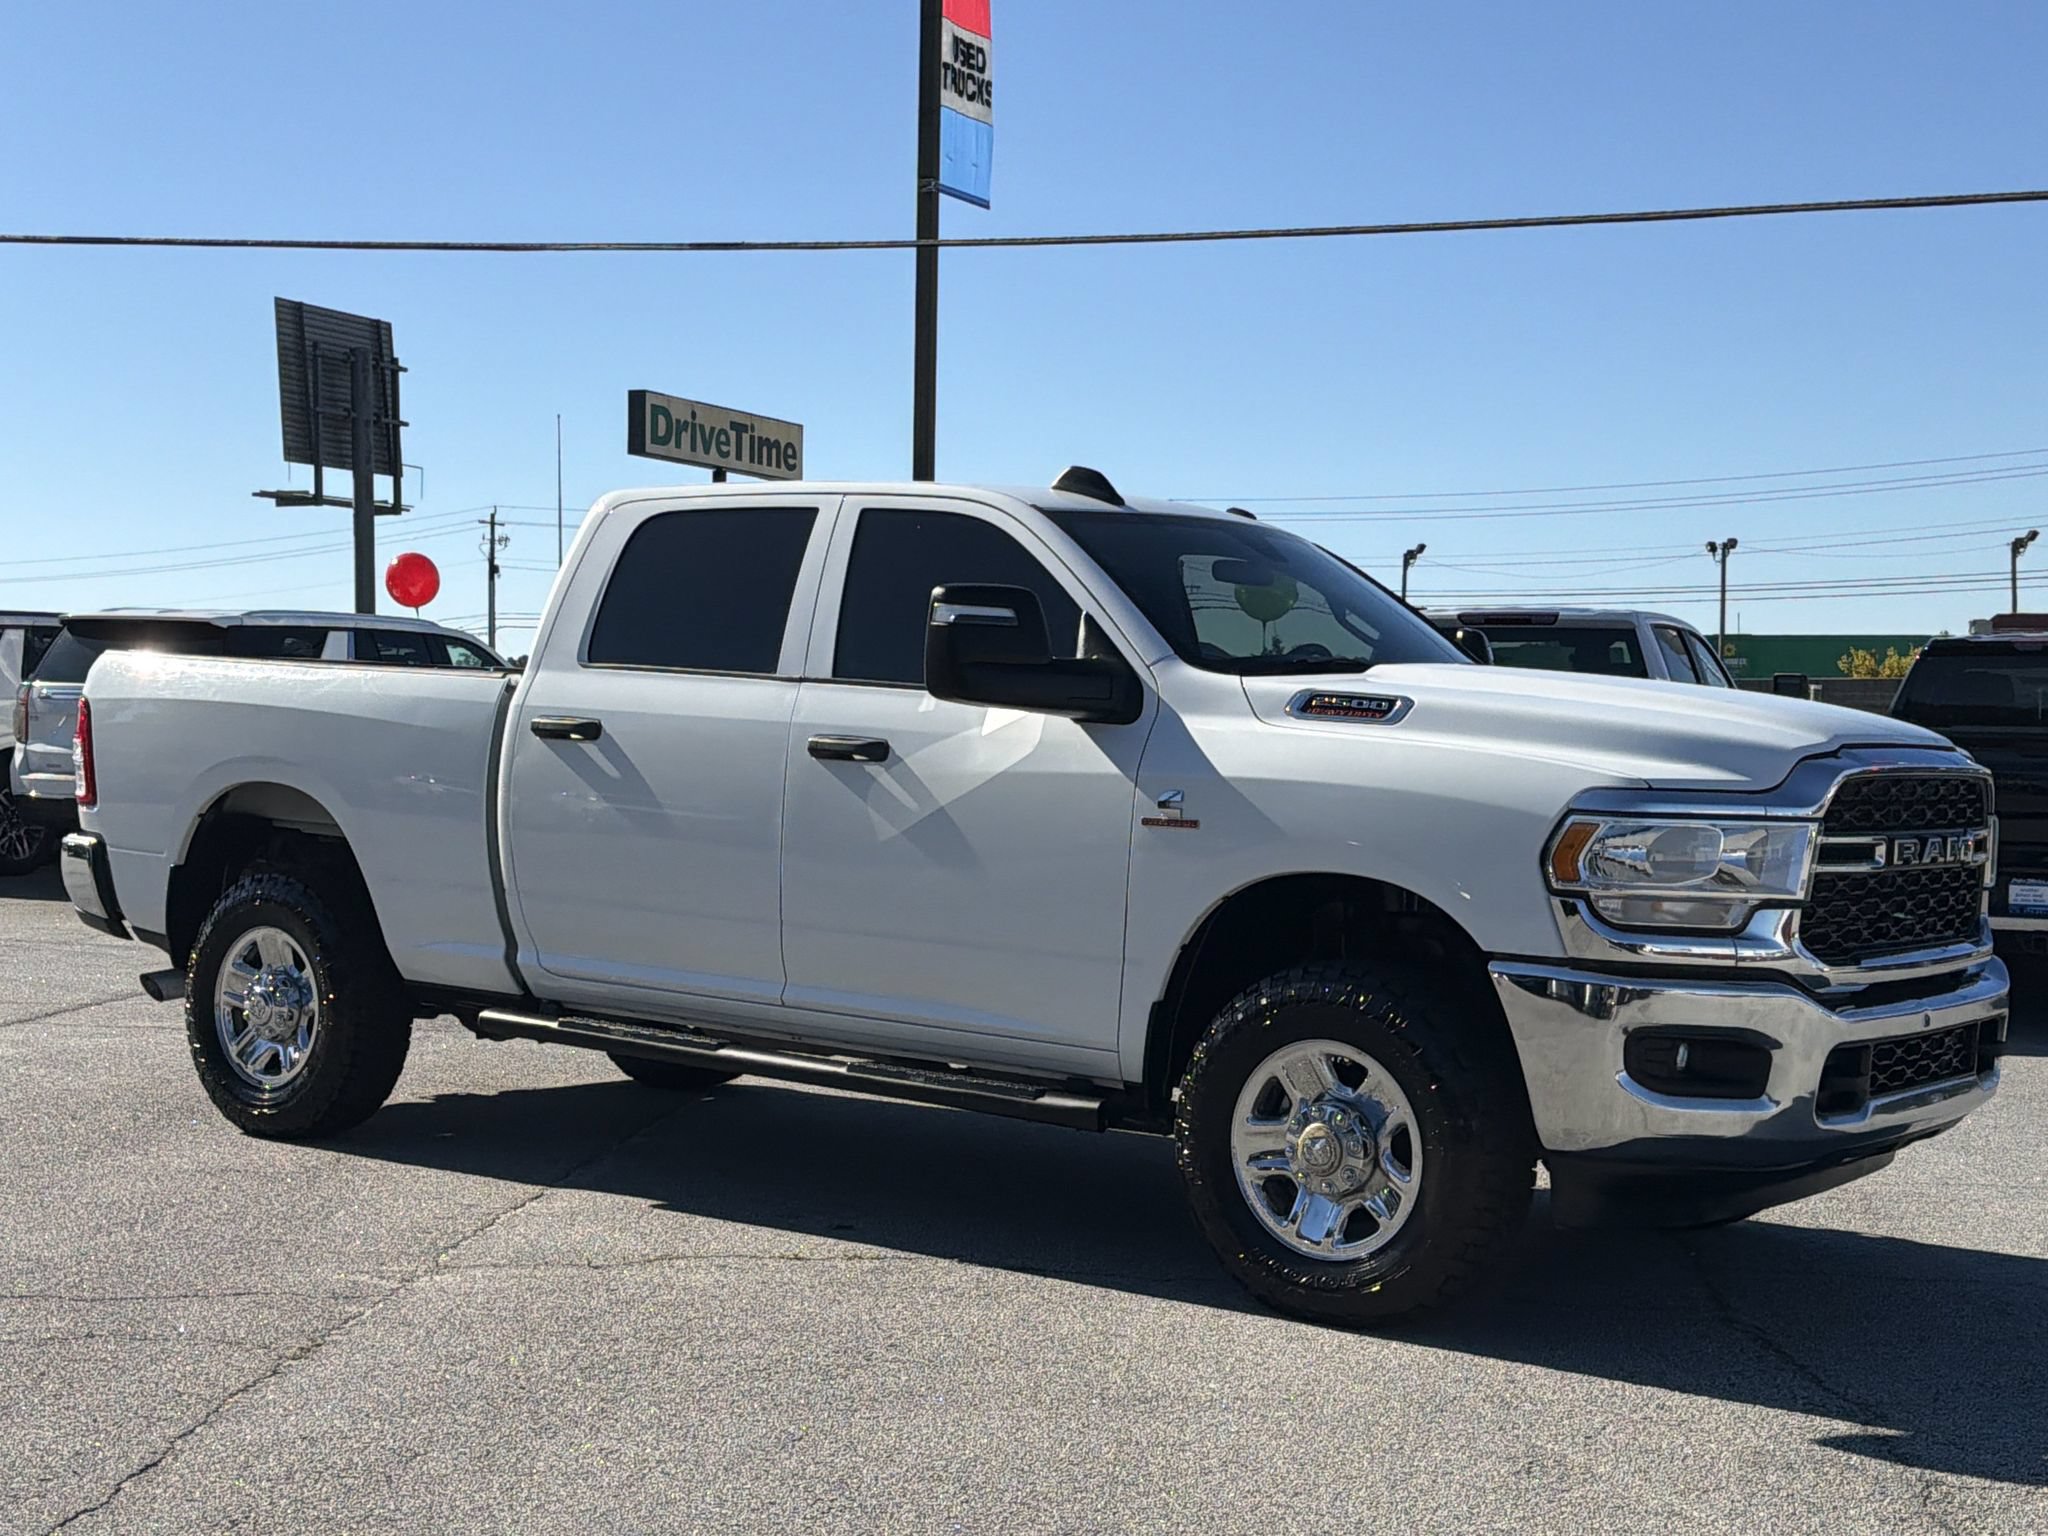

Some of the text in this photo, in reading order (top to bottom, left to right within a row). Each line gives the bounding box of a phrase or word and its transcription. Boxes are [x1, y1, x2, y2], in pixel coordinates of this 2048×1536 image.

[952, 32, 987, 74] USED
[942, 61, 993, 109] TRUCKS
[650, 403, 798, 472] DriveTime
[1311, 696, 1390, 711] 2500
[1893, 836, 1974, 865] RAM
